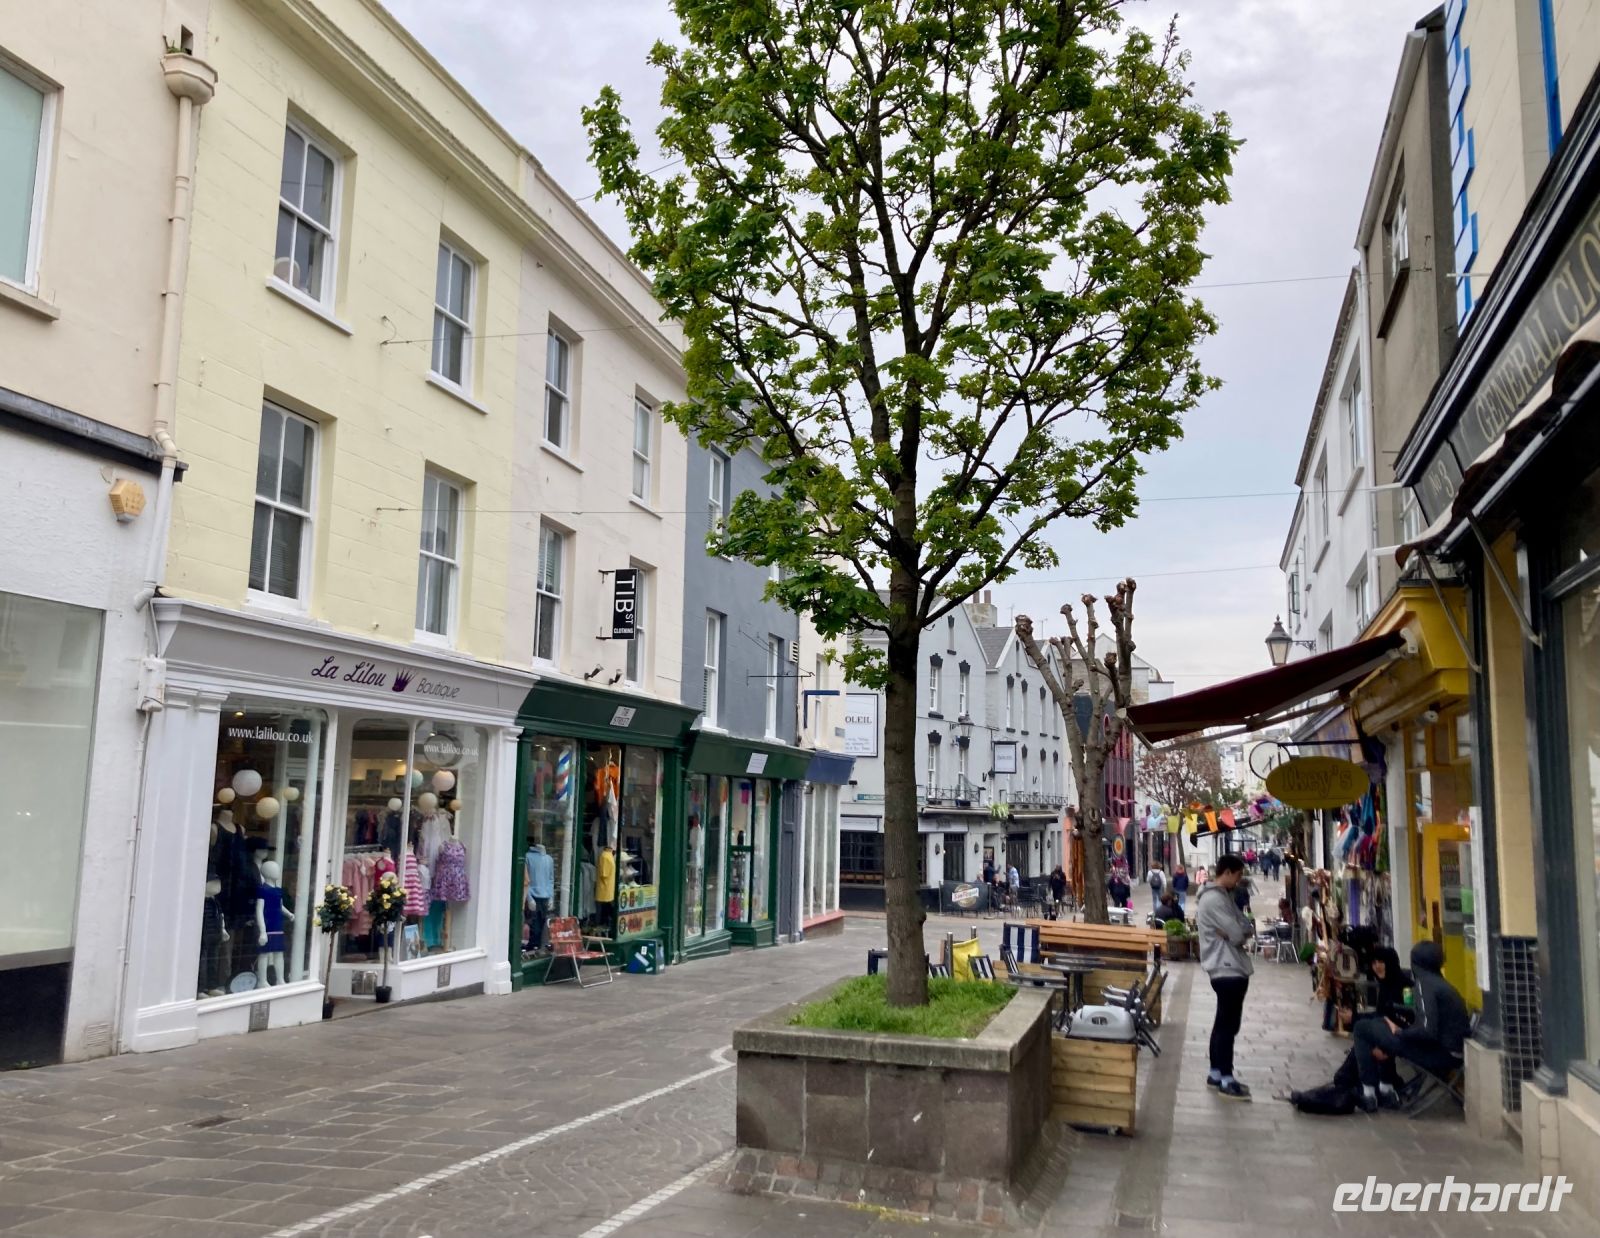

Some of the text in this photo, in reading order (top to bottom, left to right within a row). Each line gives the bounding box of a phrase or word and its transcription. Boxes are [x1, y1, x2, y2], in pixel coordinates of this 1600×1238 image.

[1475, 308, 1563, 443] GENERAL
[1438, 460, 1455, 497] 3
[615, 574, 635, 625] TIB ST
[311, 655, 461, 699] La Lilou Boutique
[228, 726, 313, 743] www.lalilou.co.uk
[845, 716, 872, 724] OLEIL
